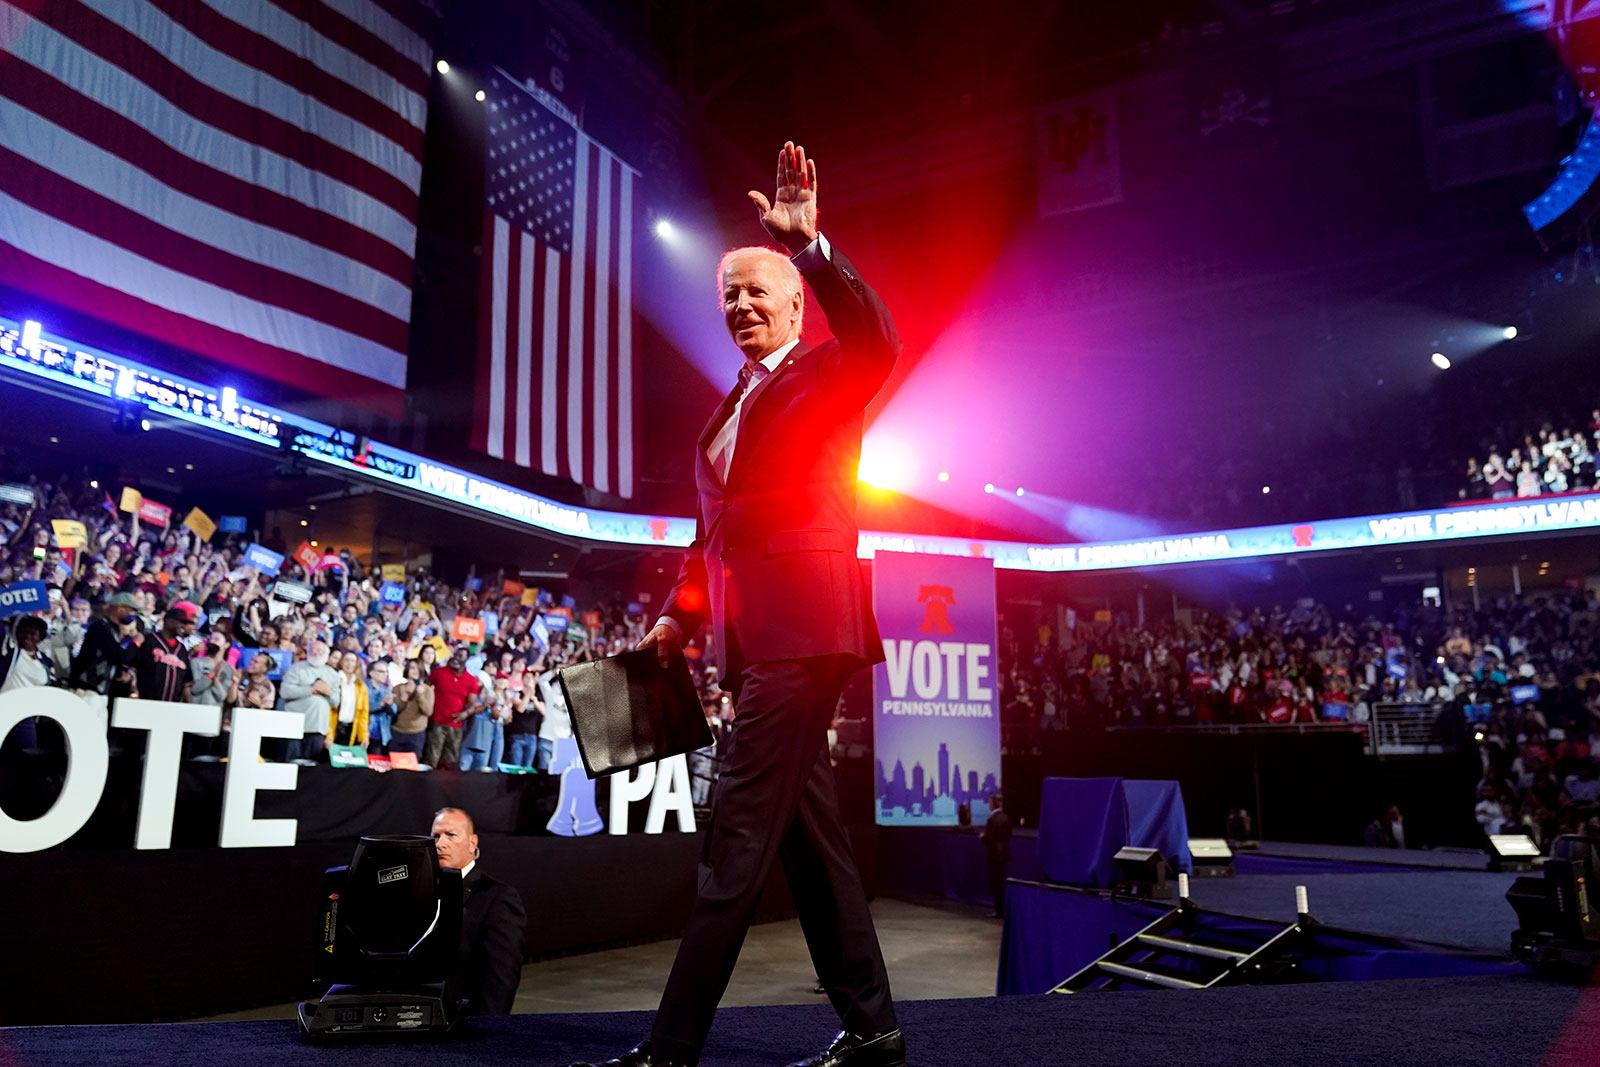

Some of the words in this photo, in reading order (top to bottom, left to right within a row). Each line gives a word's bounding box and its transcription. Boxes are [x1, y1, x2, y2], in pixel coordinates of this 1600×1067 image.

[419, 463, 467, 498] VOTE
[468, 479, 590, 533] PENNSYLVANIA
[1027, 547, 1076, 567] VOTE
[1078, 535, 1230, 565] PENNSYLVANIA
[1370, 515, 1431, 540] VOTE
[882, 638, 992, 701] VOTE
[882, 700, 993, 718] PENNSYLVANIA
[608, 752, 698, 836] PA
